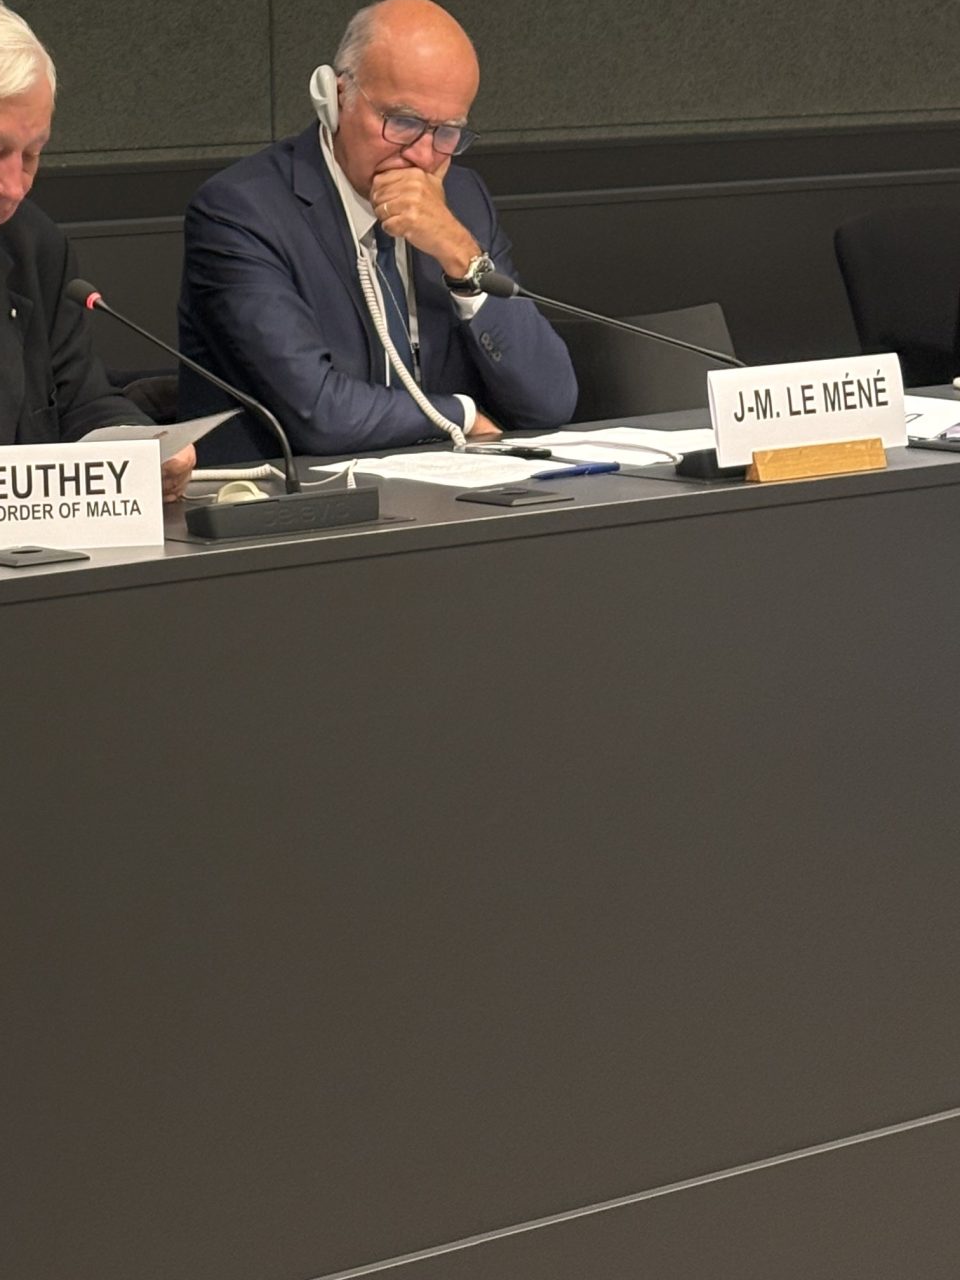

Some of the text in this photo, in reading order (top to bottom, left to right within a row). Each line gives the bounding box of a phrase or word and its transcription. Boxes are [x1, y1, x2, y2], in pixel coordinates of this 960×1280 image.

[733, 368, 889, 424] J-M. LE MÉNÉ
[59, 502, 81, 520] OF
[86, 499, 142, 519] MALTA
